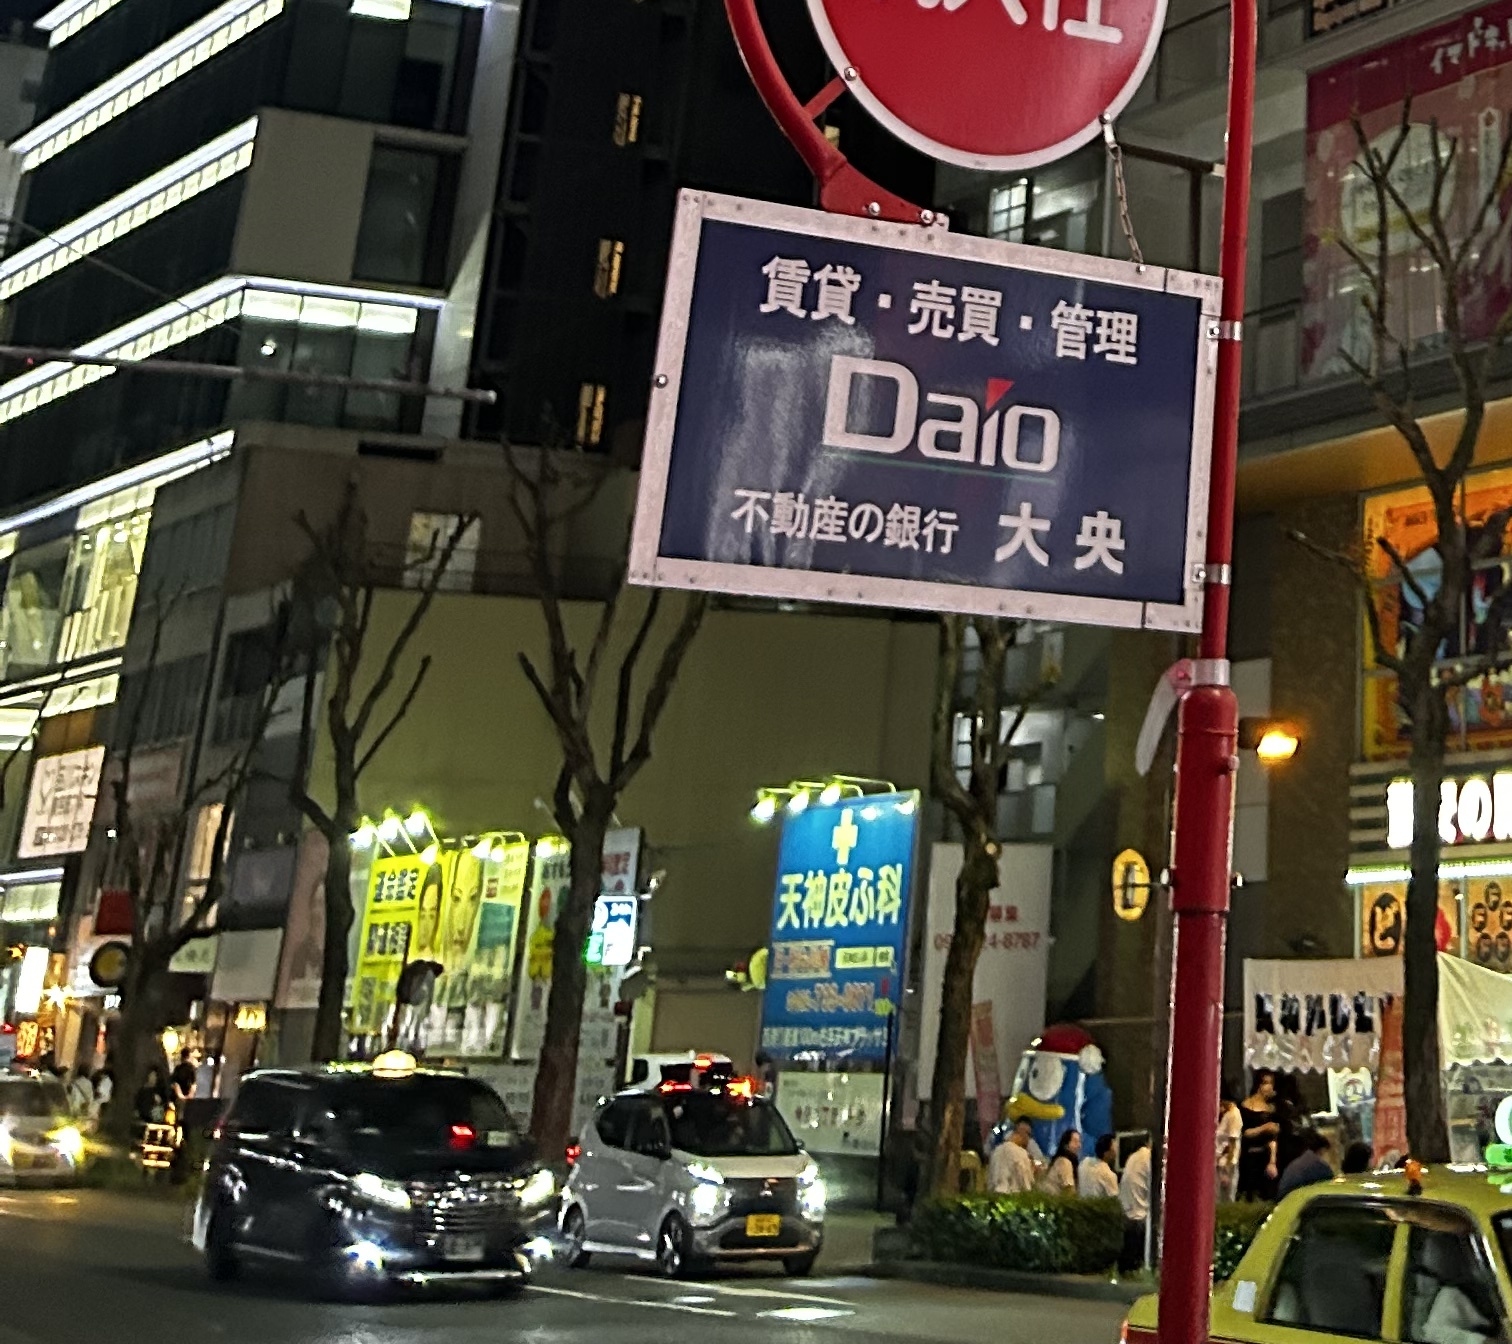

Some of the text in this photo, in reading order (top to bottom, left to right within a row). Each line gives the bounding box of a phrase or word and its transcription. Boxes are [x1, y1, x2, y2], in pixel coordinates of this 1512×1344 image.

[823, 354, 1062, 472] Daio
[731, 488, 959, 554] 不動産の銀行
[777, 864, 902, 929] 天神皮ふ科
